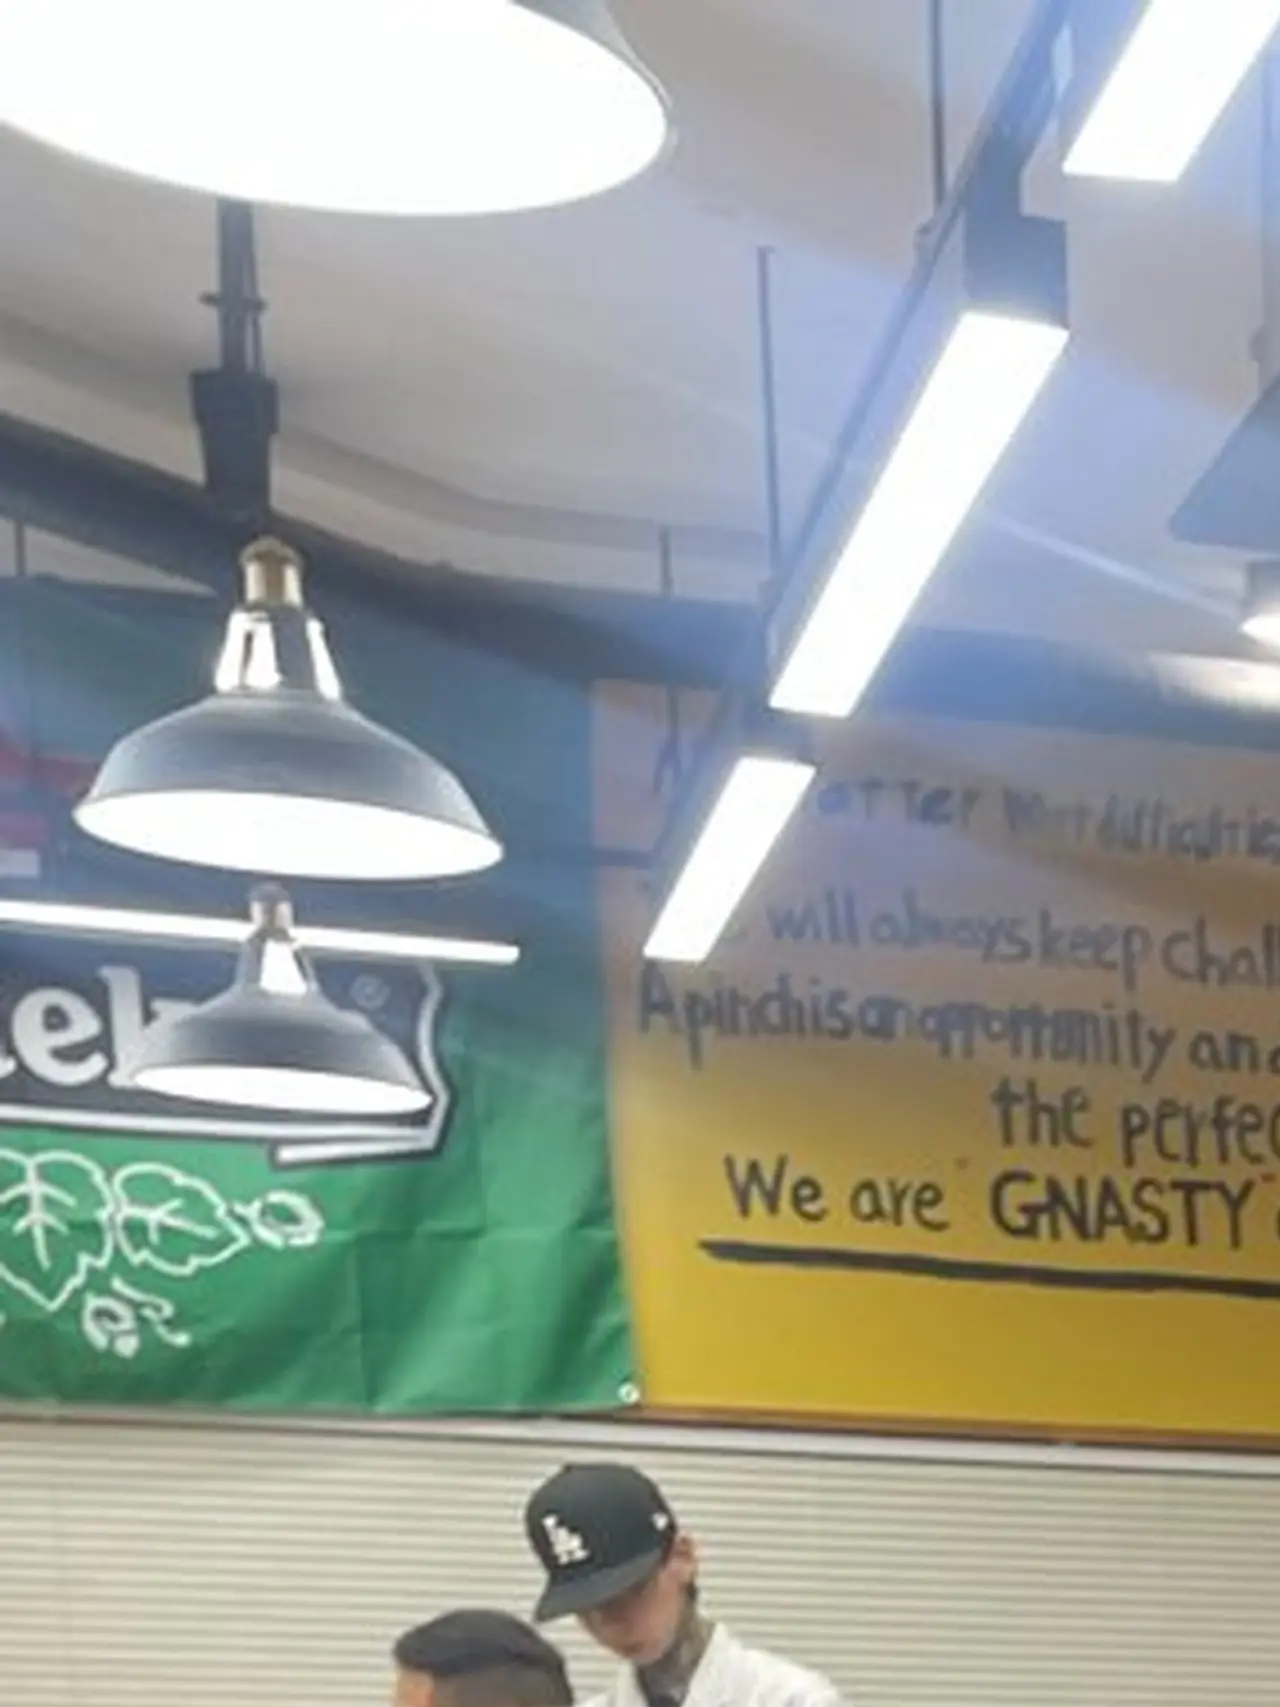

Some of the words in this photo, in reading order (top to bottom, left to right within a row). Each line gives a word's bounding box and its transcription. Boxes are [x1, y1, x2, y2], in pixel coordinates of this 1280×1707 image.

[1038, 905, 1152, 990] keep
[989, 1076, 1095, 1151] the
[724, 1154, 828, 1224] We
[849, 1172, 952, 1234] are
